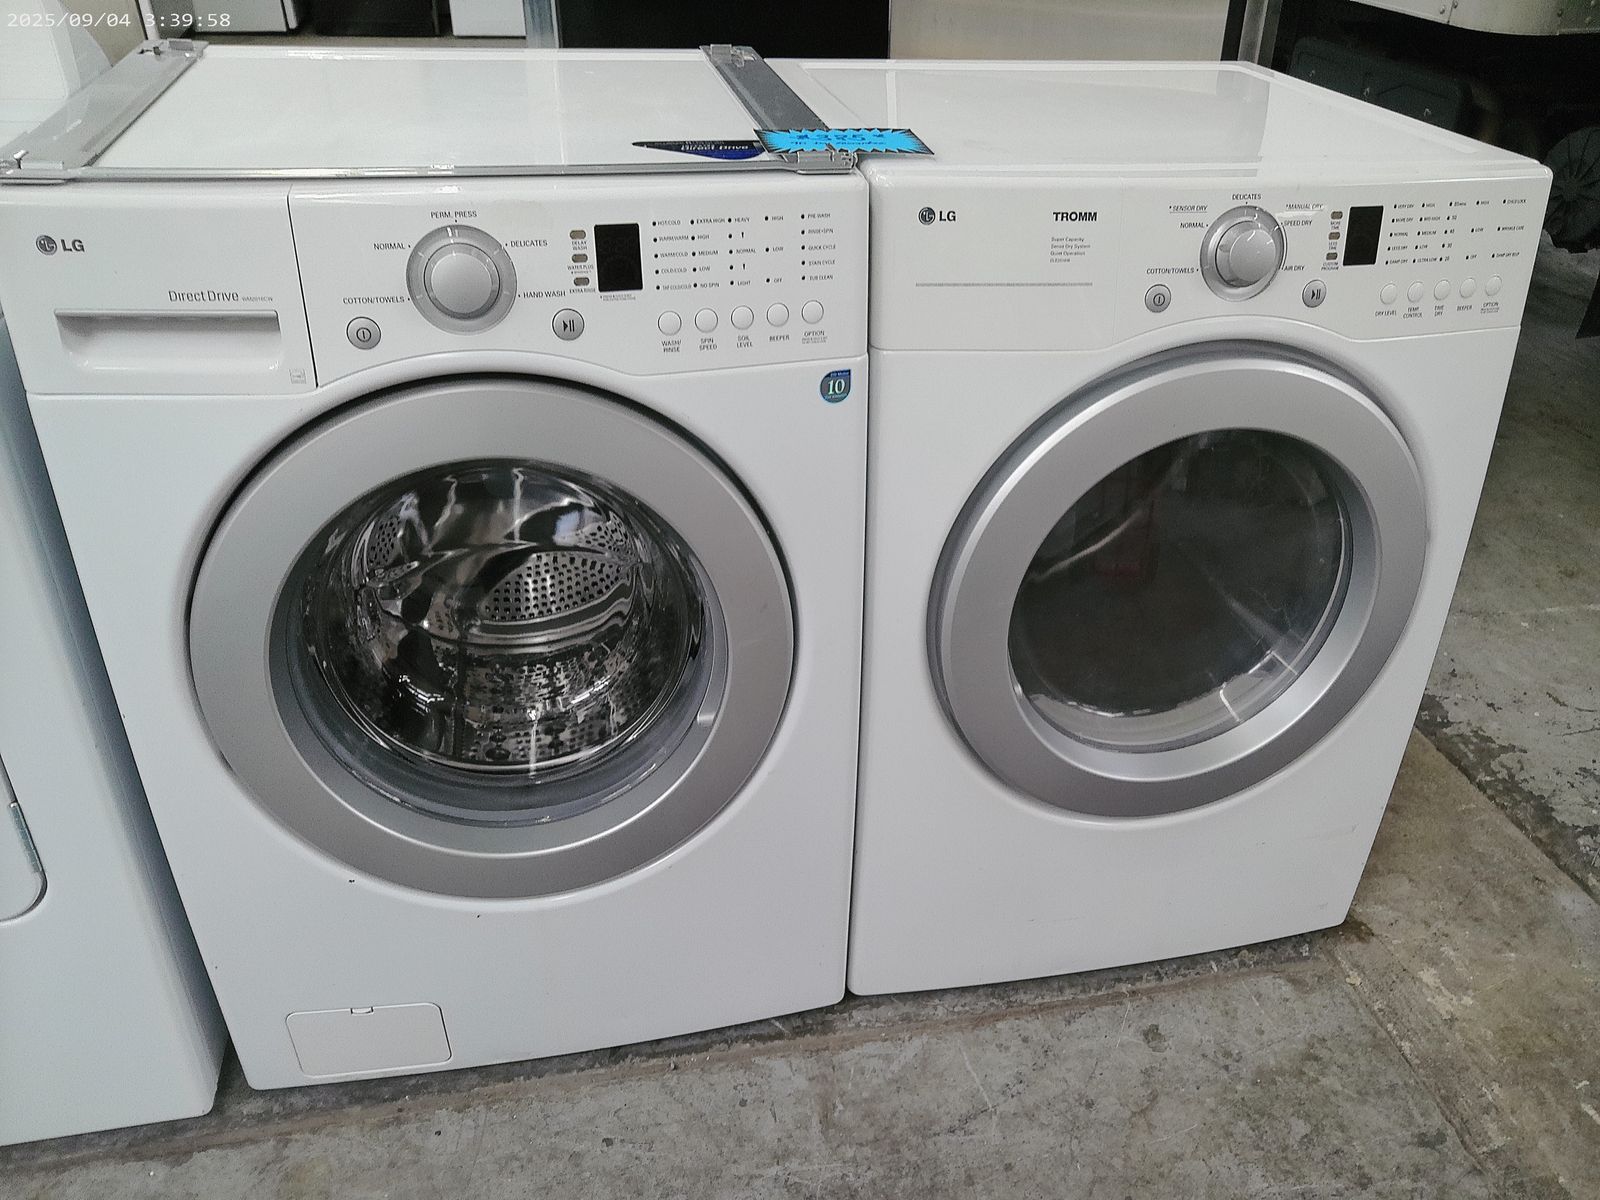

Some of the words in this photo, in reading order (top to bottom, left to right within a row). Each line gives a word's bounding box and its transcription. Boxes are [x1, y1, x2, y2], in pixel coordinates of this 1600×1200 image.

[939, 211, 956, 222] LG
[1053, 211, 1098, 222] TROMM
[60, 239, 85, 252] LG
[373, 242, 405, 250] NORMAL
[168, 290, 206, 302] Direct
[207, 290, 239, 302] Drive
[343, 296, 405, 304] COTTON/TOWELS
[523, 291, 543, 299] HAND
[544, 290, 566, 298] WASH
[769, 334, 790, 342] BEEPER
[828, 378, 845, 395] 10
